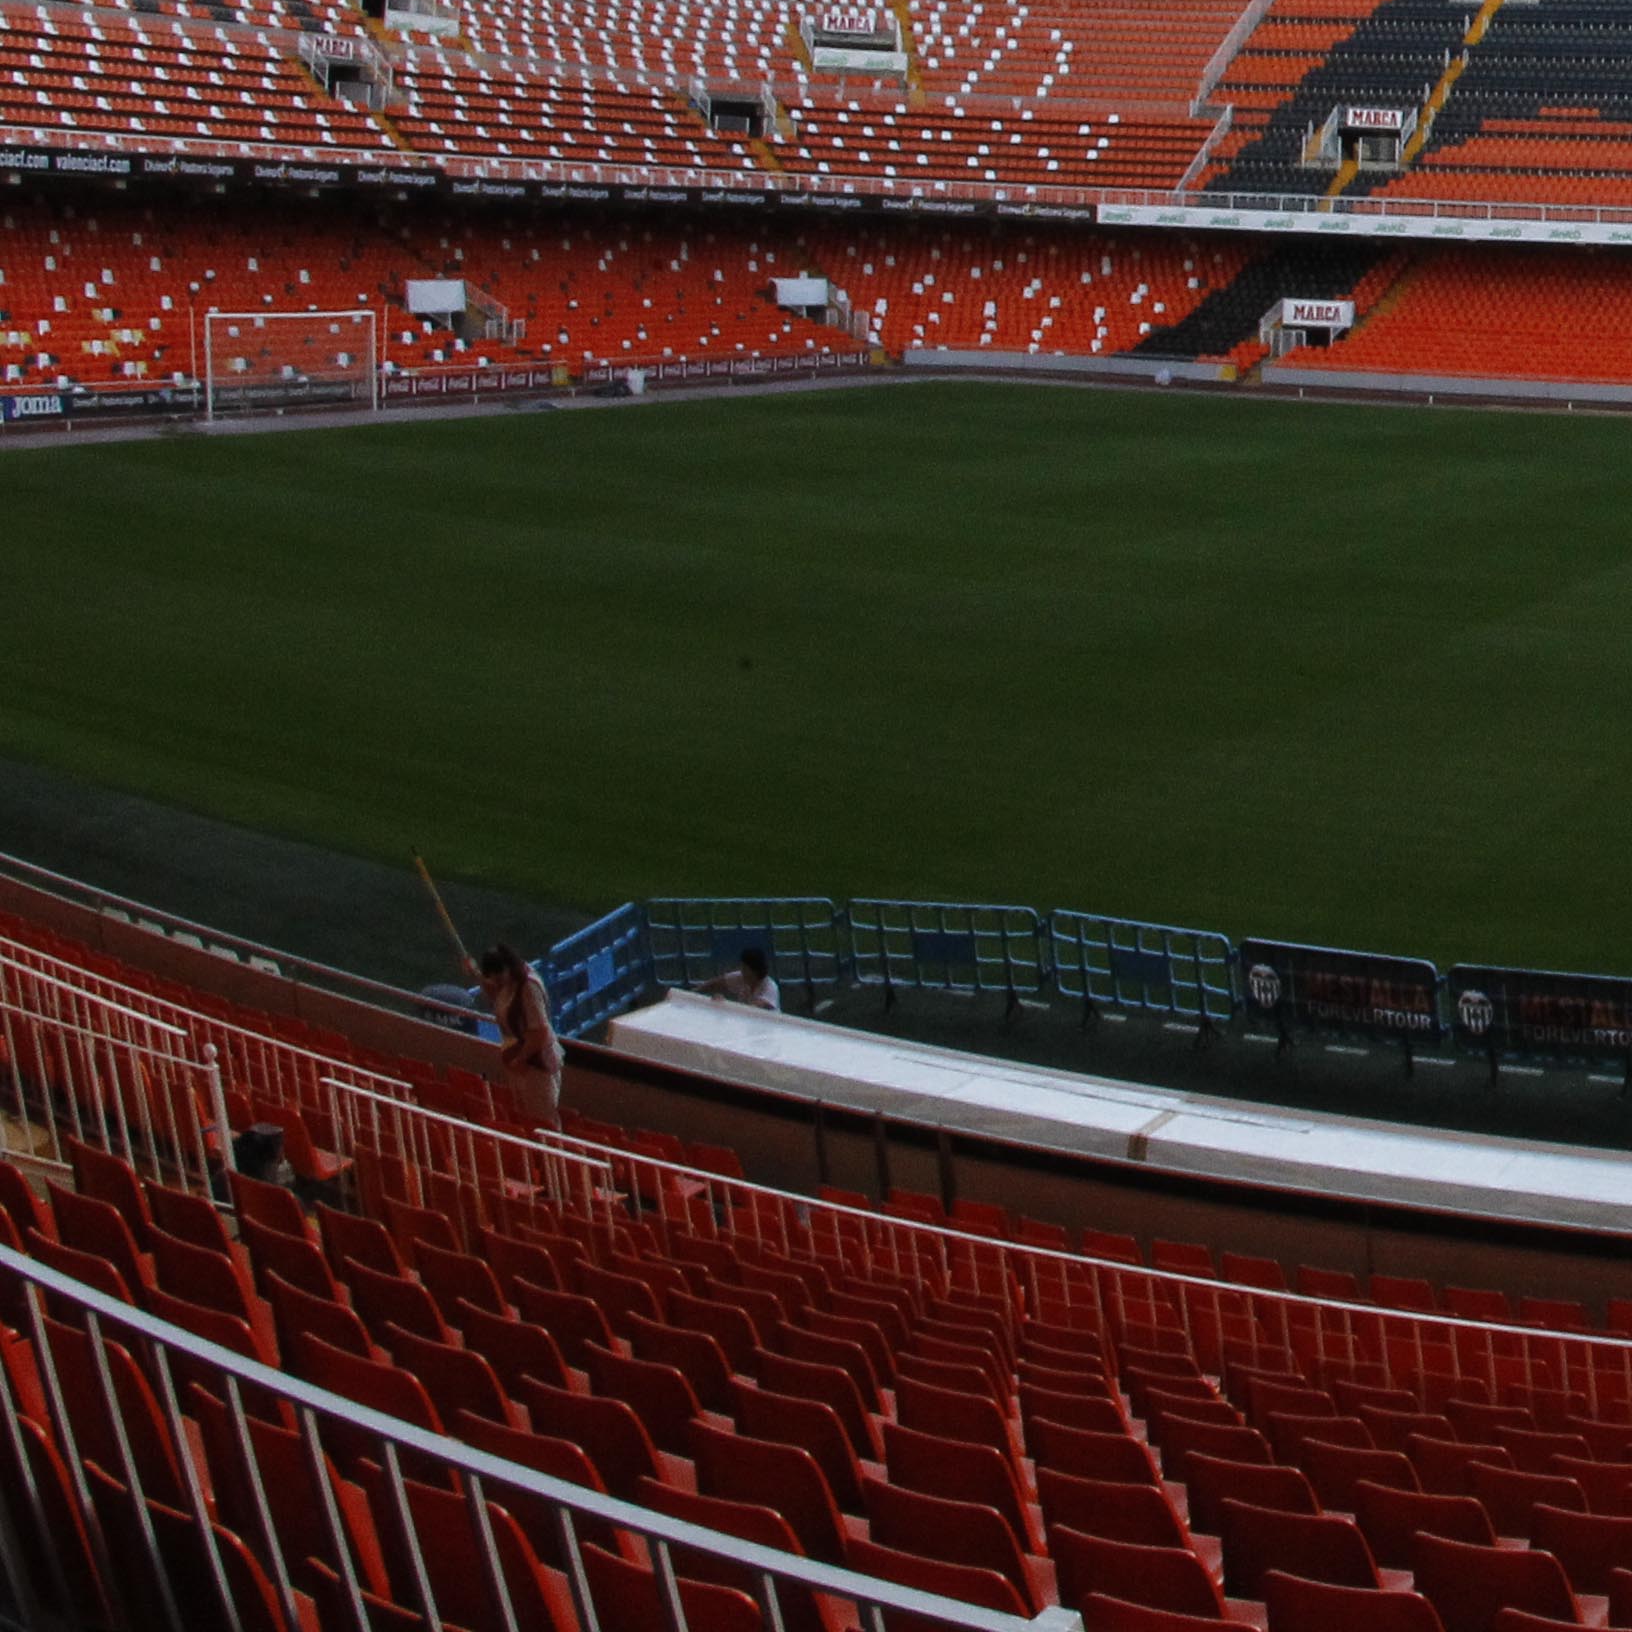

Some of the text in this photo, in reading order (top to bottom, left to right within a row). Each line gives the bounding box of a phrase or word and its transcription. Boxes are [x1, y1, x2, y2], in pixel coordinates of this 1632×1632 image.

[828, 15, 870, 31] MARCA
[1351, 109, 1397, 125] MARCA
[1294, 306, 1340, 320] MARCA
